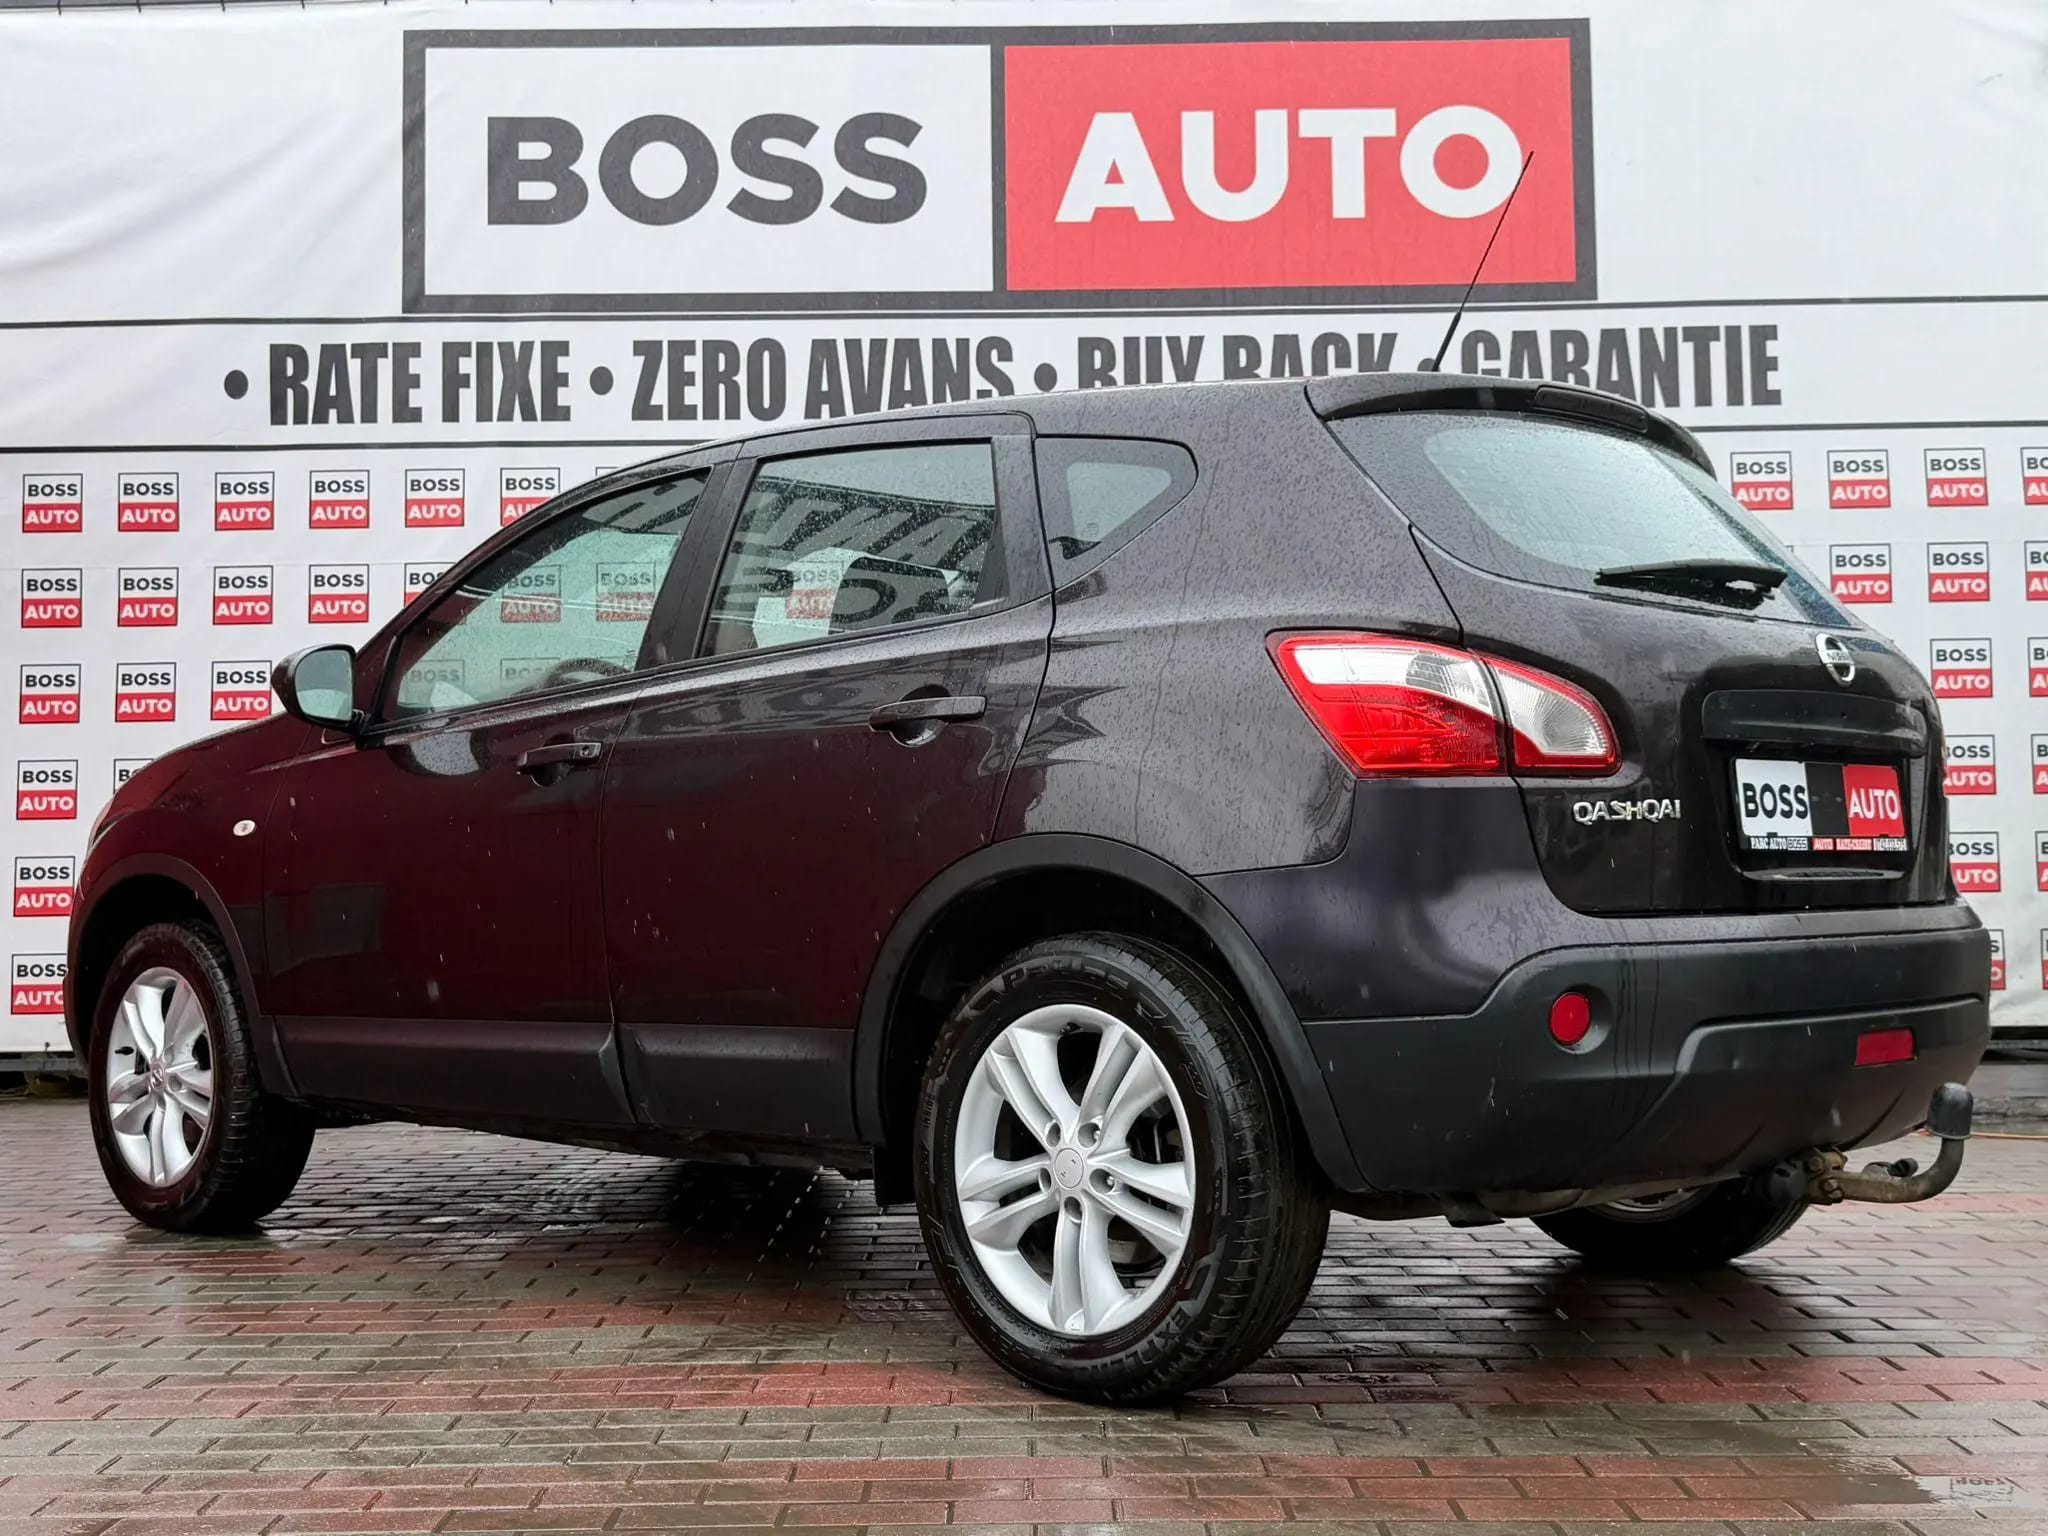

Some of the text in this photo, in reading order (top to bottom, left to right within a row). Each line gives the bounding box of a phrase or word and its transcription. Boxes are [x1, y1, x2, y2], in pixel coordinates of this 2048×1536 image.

[487, 105, 1525, 226] BOSS AUTO
[269, 342, 422, 426] RATE
[442, 340, 571, 424] FIXE
[632, 337, 787, 421] ZERO
[804, 335, 1016, 420] AVANS
[1461, 324, 1782, 408] GARANTIE
[1736, 461, 1787, 475] BOSS
[1833, 459, 1884, 473] BOSS
[1930, 457, 1981, 471] BOSS
[2027, 457, 2048, 469] BO
[27, 483, 78, 497] BOSS
[123, 482, 175, 496] BOSS
[220, 481, 270, 496] BOSS
[314, 479, 365, 494] BOSS
[410, 478, 460, 492] BOSS
[505, 477, 556, 490] BOSS
[1930, 483, 1986, 499] AUTO
[1735, 486, 1791, 503] AUTO
[1832, 484, 1888, 501] AUTO
[24, 509, 80, 524] AUTO
[121, 508, 176, 523] AUTO
[217, 507, 271, 522] AUTO
[311, 505, 367, 521] AUTO
[407, 503, 462, 520] AUTO
[503, 503, 540, 518] AU
[1835, 553, 1887, 568] BOSS
[1932, 552, 1985, 566] BOSS
[26, 578, 78, 592] BOSS
[123, 577, 174, 591] BOSS
[218, 575, 269, 589] BOSS
[313, 573, 365, 588] BOSS
[409, 572, 445, 585] BO
[1931, 578, 1988, 594] AUTO
[1833, 579, 1890, 596] AUTO
[24, 604, 79, 619] AUTO
[120, 603, 175, 618] AUTO
[215, 601, 270, 617] AUTO
[311, 599, 367, 615] AUTO
[1935, 648, 1988, 662] BOSS
[25, 673, 76, 688] BOSS
[121, 672, 172, 687] BOSS
[216, 670, 267, 685] BOSS
[1934, 674, 1991, 690] AUTO
[22, 700, 77, 715] AUTO
[118, 698, 173, 714] AUTO
[213, 697, 269, 712] AUTO
[22, 769, 73, 784] BOSS
[19, 796, 74, 811] AUTO
[1742, 782, 1899, 820] BOSS AUTO
[1573, 798, 1681, 825] QASHQAI
[19, 866, 70, 881] BOSS
[1956, 868, 1999, 884] UTO
[16, 893, 71, 908] AUTO
[16, 963, 68, 978] BOSS
